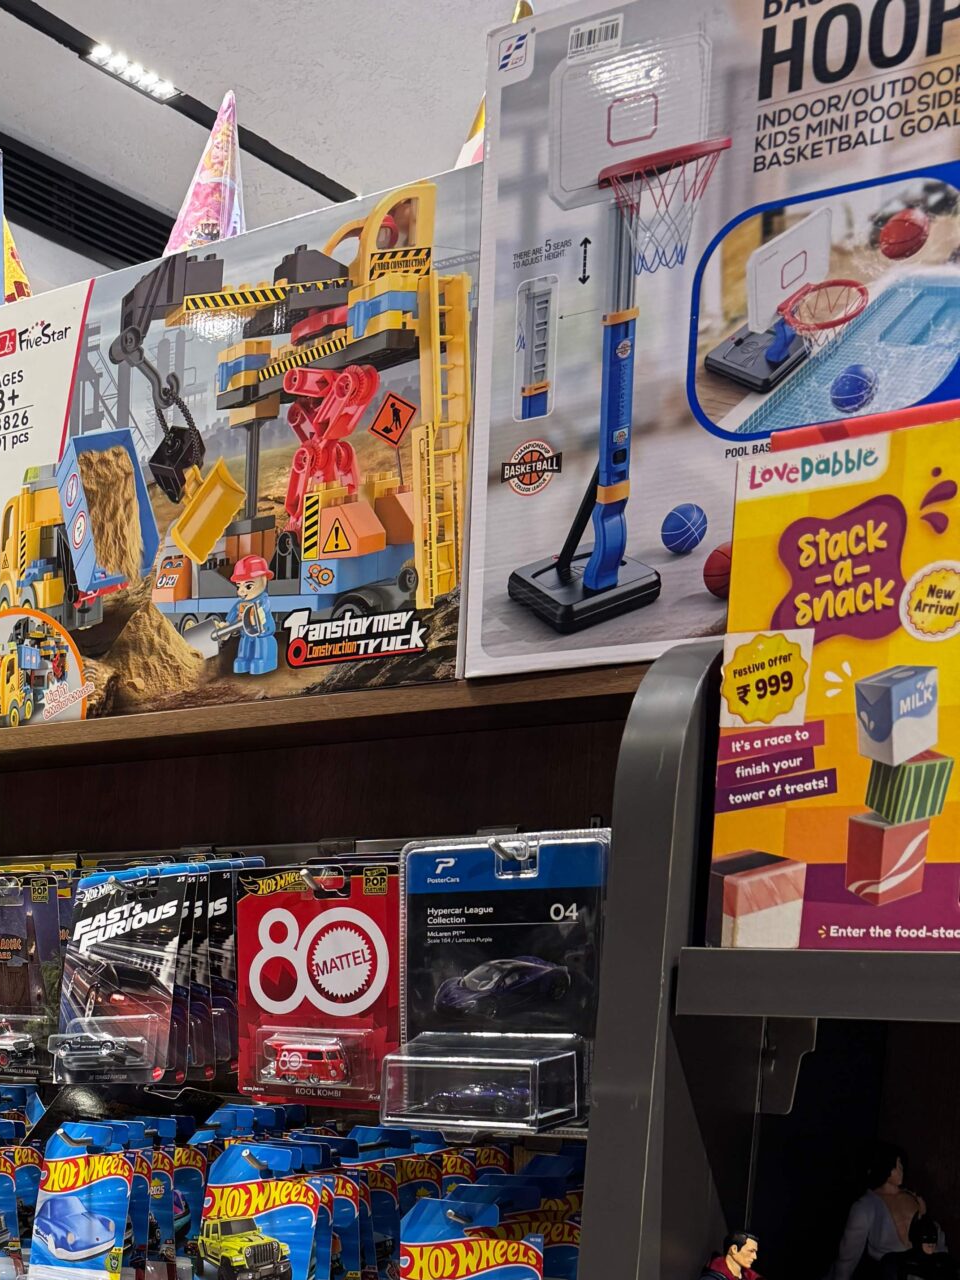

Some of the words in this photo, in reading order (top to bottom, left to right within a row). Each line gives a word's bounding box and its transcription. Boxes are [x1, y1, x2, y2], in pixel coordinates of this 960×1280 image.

[754, 126, 800, 153] KIDS
[805, 114, 849, 141] MINI
[753, 125, 894, 173] BASKETBALL
[513, 249, 529, 261] THERE
[545, 240, 552, 253] 5
[513, 261, 520, 269] TO
[18, 323, 71, 351] FiveStar
[12, 432, 29, 449] pcs
[514, 442, 551, 460] CHAMPIONSHIP
[725, 446, 749, 458] POOL
[504, 456, 559, 479] BASKETBALL
[798, 520, 887, 568] Stack
[794, 577, 895, 626] Snack
[927, 584, 955, 600] New
[914, 601, 958, 616] Arrival
[307, 640, 357, 659] Construction
[733, 660, 766, 678] Festive
[768, 653, 792, 668] Offer
[45, 683, 69, 705] Light
[754, 671, 793, 700] 999
[899, 687, 934, 716] MILK
[732, 739, 750, 752] It's
[754, 741, 761, 749] a
[764, 734, 792, 747] race
[795, 730, 809, 740] to
[735, 764, 770, 779] finish
[773, 757, 803, 775] your
[729, 790, 765, 805] tower
[768, 785, 782, 798] of
[785, 776, 828, 794] treats!
[365, 878, 387, 887] POP
[73, 901, 135, 941] FAST
[132, 903, 143, 915] &
[427, 906, 462, 917] Hypercar
[464, 905, 493, 915] League
[427, 916, 466, 924] Collection
[550, 903, 578, 921] 04
[78, 900, 178, 954] FURIOUS
[830, 925, 867, 938] Enter
[870, 925, 891, 938] the
[249, 906, 390, 1017] 80
[314, 948, 372, 980] MATTEL
[295, 1087, 315, 1097] KOOL
[316, 1088, 341, 1098] KOMBI
